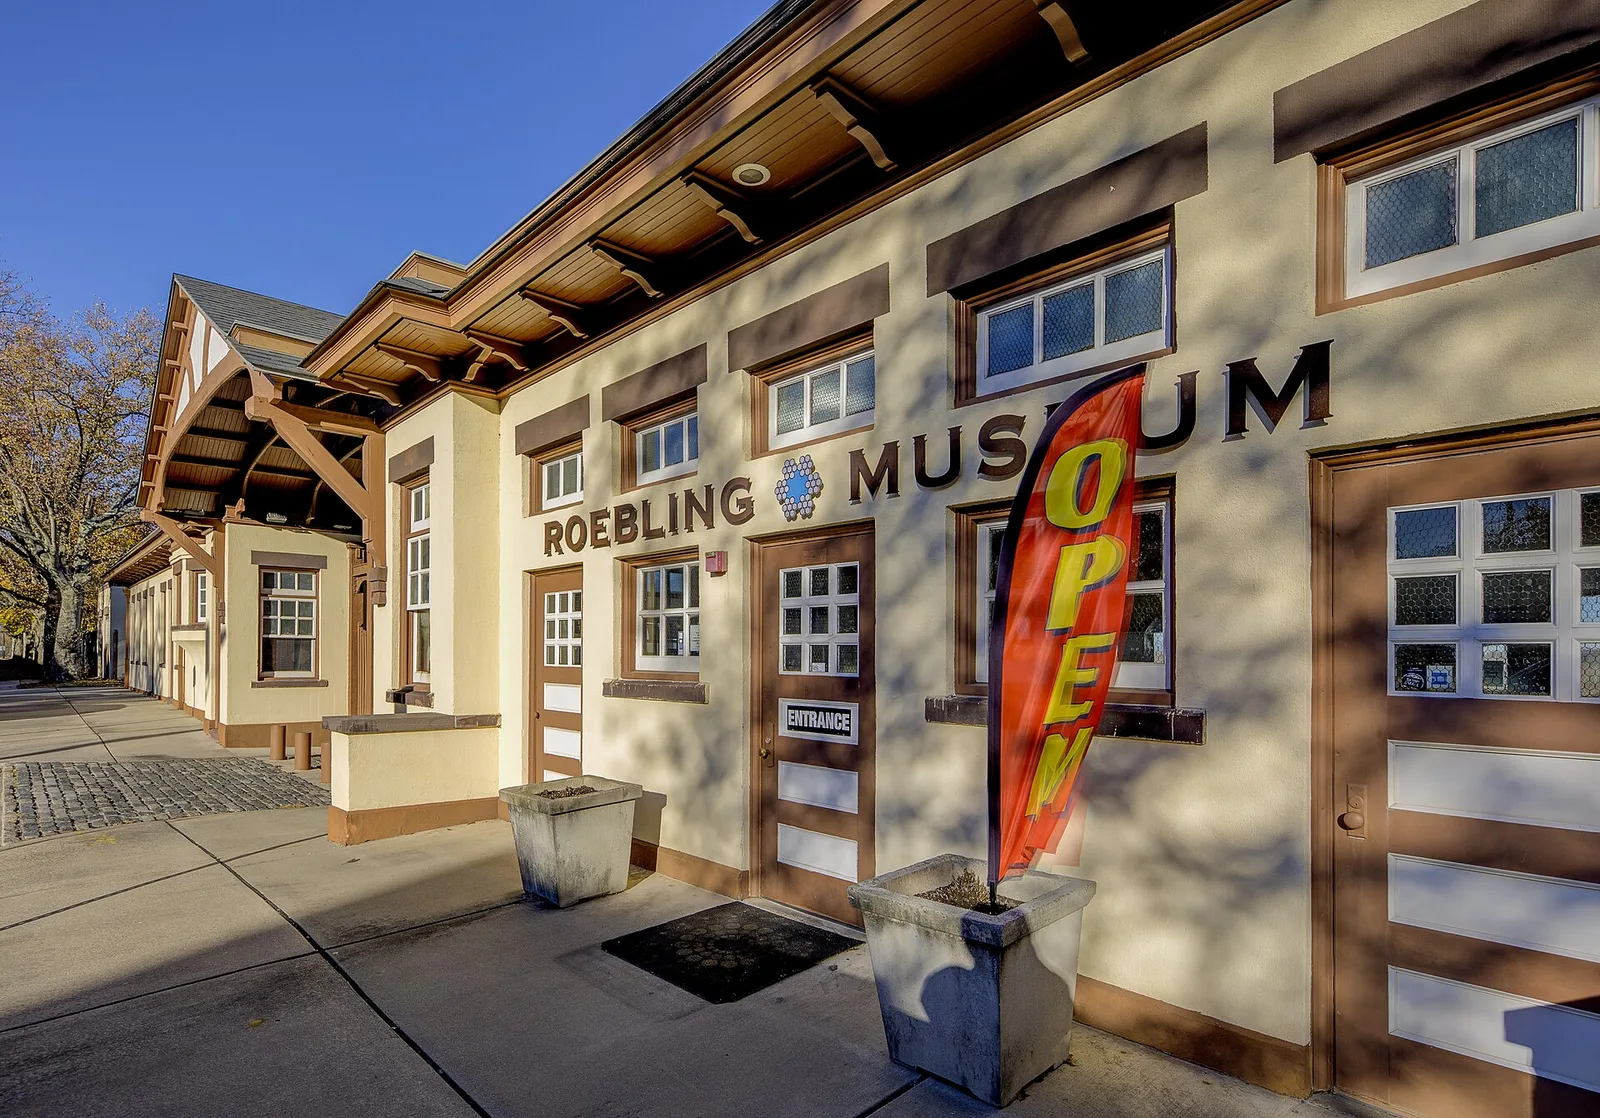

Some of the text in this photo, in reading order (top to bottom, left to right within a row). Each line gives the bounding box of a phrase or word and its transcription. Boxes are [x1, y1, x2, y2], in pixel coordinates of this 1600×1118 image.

[543, 338, 1335, 557] ROEBLING MUSUM
[787, 709, 851, 731] ENTRANCE
[1024, 437, 1128, 821] OPEN
